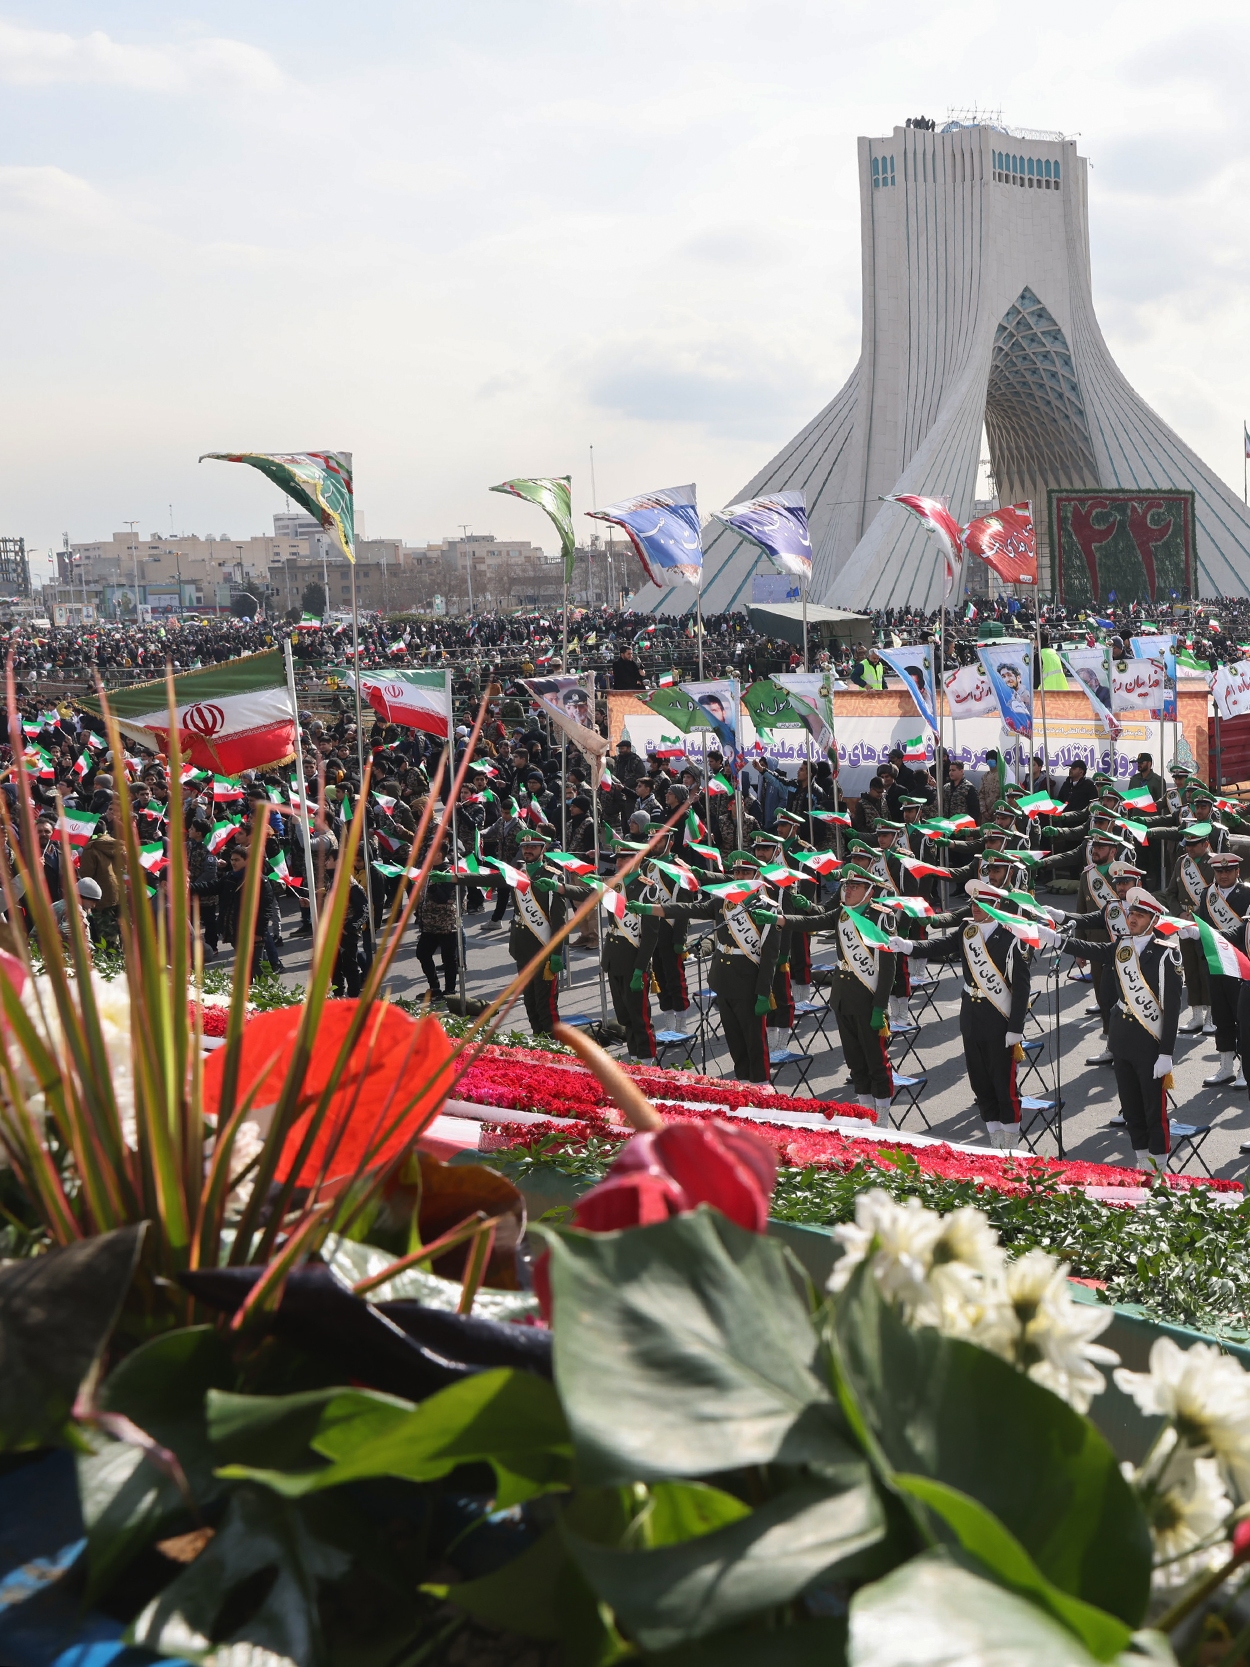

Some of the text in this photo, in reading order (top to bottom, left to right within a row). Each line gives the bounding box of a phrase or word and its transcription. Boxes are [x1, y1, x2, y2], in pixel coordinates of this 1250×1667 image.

[525, 905, 544, 927] دژبان
[843, 928, 875, 977] دژبان ارتش
[969, 942, 1002, 995] دژبان ارتش
[1124, 965, 1159, 1022] دژبان ارتش
